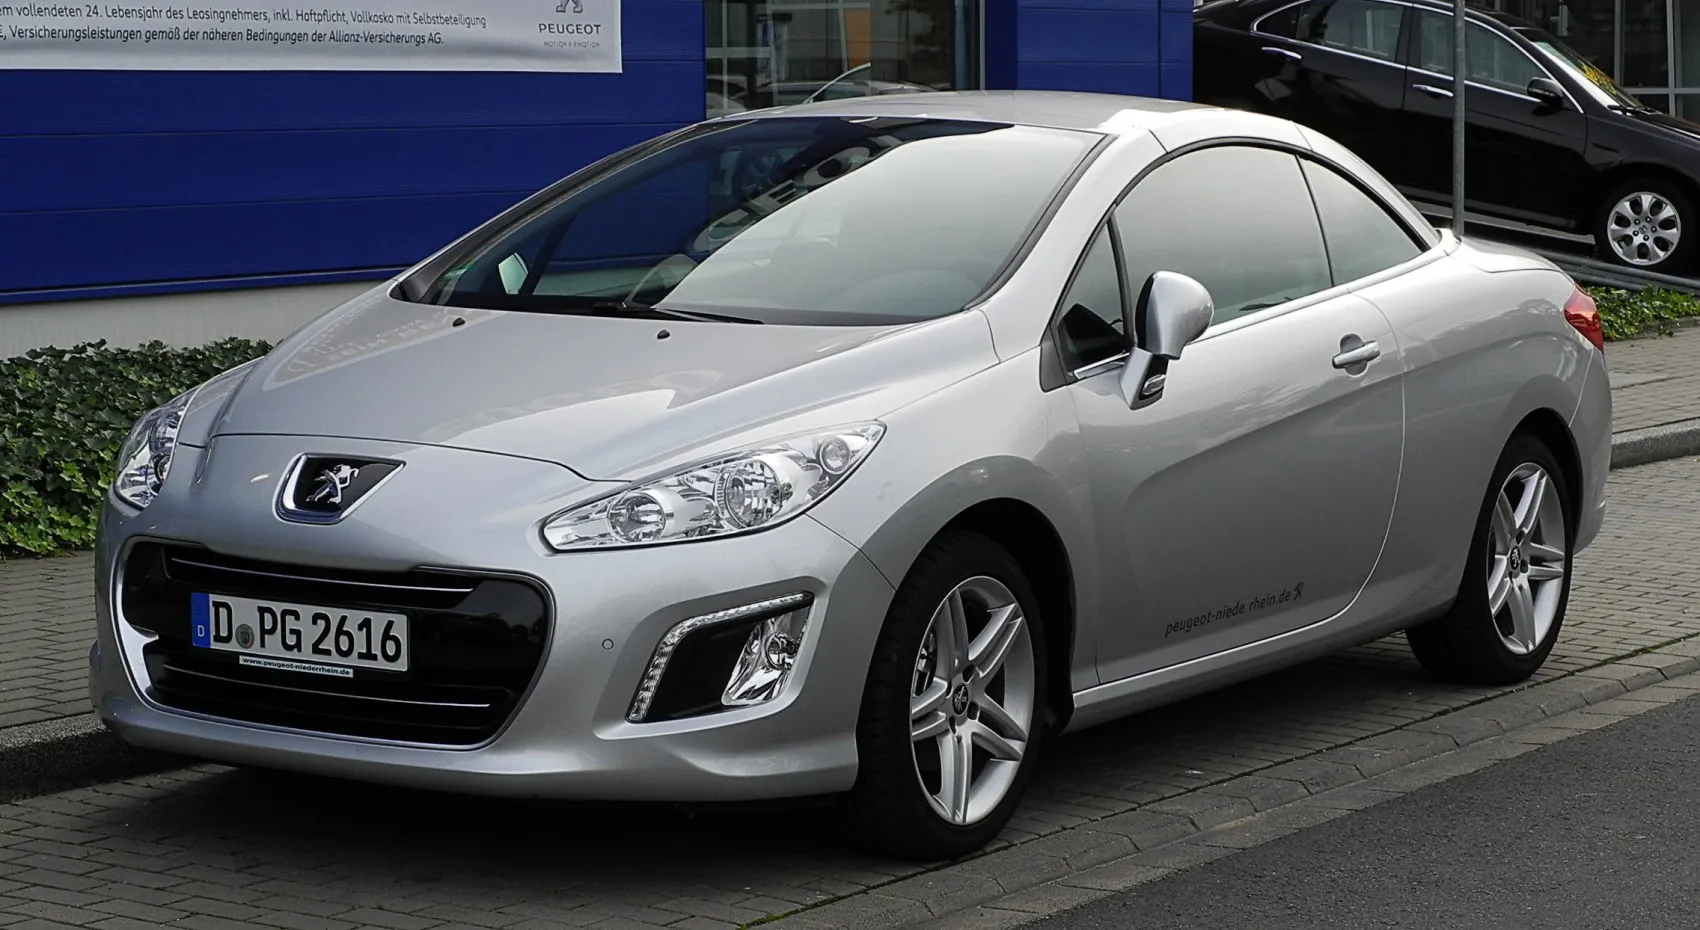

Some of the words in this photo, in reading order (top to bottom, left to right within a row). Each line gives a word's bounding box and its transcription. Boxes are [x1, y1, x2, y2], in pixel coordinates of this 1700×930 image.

[0, 6, 13, 16] m
[16, 3, 82, 17] vollendeten
[85, 4, 102, 17] 24.
[105, 5, 162, 21] Lebensjahr
[166, 6, 184, 19] des
[186, 7, 271, 23] Leasingnehmers,
[273, 8, 293, 21] inkl.
[296, 9, 349, 24] Haftpflicht,
[350, 11, 394, 24] Vollkasko
[396, 12, 411, 24] mit
[413, 12, 487, 28] Selbstbeteiligung
[9, 24, 141, 43] Versicherungsleistungen
[144, 26, 180, 43] gemäß
[183, 28, 200, 41] der
[202, 28, 243, 41] näheren
[246, 29, 308, 45] Bedingungen
[311, 30, 327, 42] der
[329, 30, 426, 46] Allianz-Versicherungs
[428, 32, 444, 44] AG.
[538, 23, 602, 35] PEUGEOT
[1165, 600, 1246, 638] peugeot-niede
[1249, 588, 1292, 611] rhein.de
[197, 625, 205, 637] D
[212, 600, 234, 644] D
[257, 605, 303, 653] PG
[311, 611, 402, 664] 2616
[242, 656, 351, 677] www.peugeot-niederrhein.de
